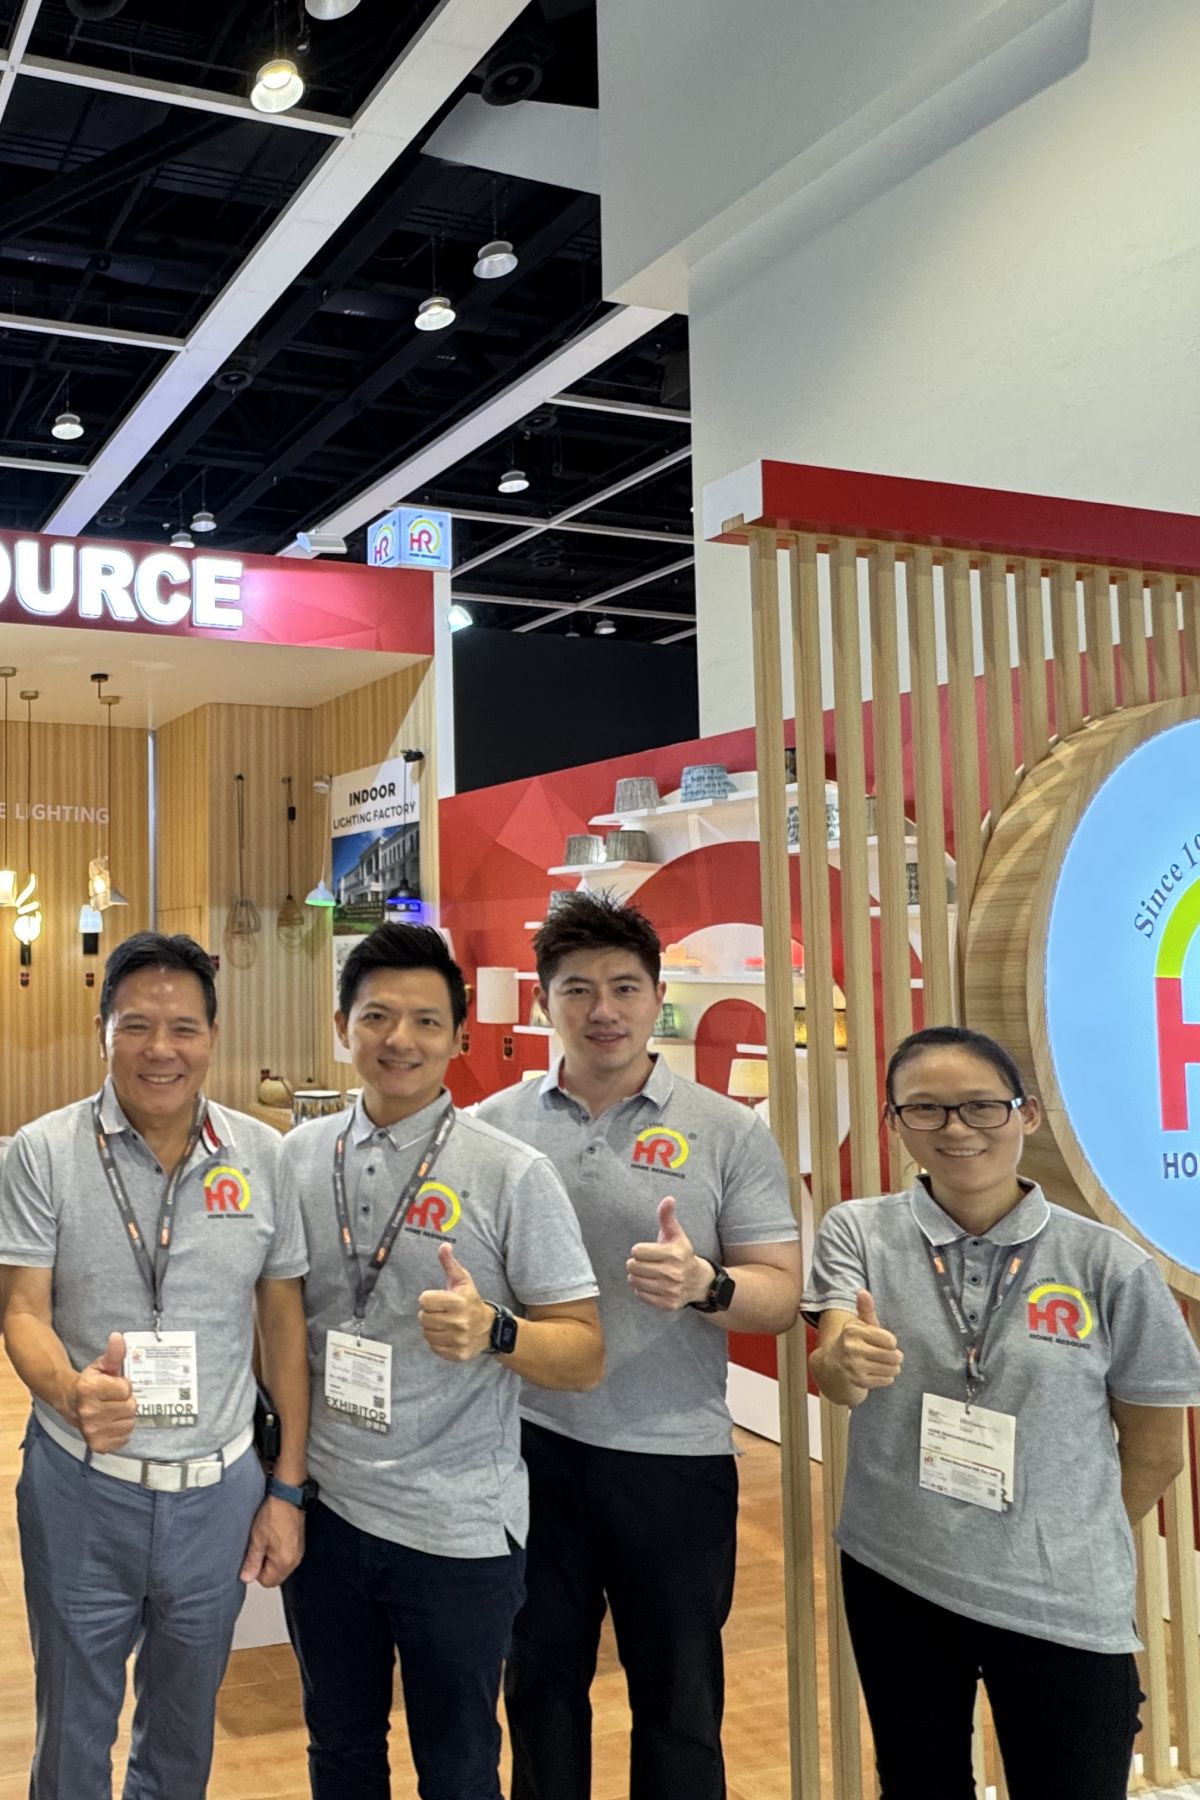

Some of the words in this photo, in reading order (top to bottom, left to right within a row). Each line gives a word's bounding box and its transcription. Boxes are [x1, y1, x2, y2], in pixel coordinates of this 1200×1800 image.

[349, 782, 396, 807] INDOOR
[333, 811, 372, 830] LIGHTING
[373, 801, 416, 821] FACTORY
[1133, 863, 1184, 939] Since
[632, 1138, 675, 1169] HR
[204, 1179, 242, 1212] HR
[406, 1195, 447, 1233] HR
[1028, 1299, 1080, 1339] HR
[135, 1403, 194, 1416] XHIBITOR
